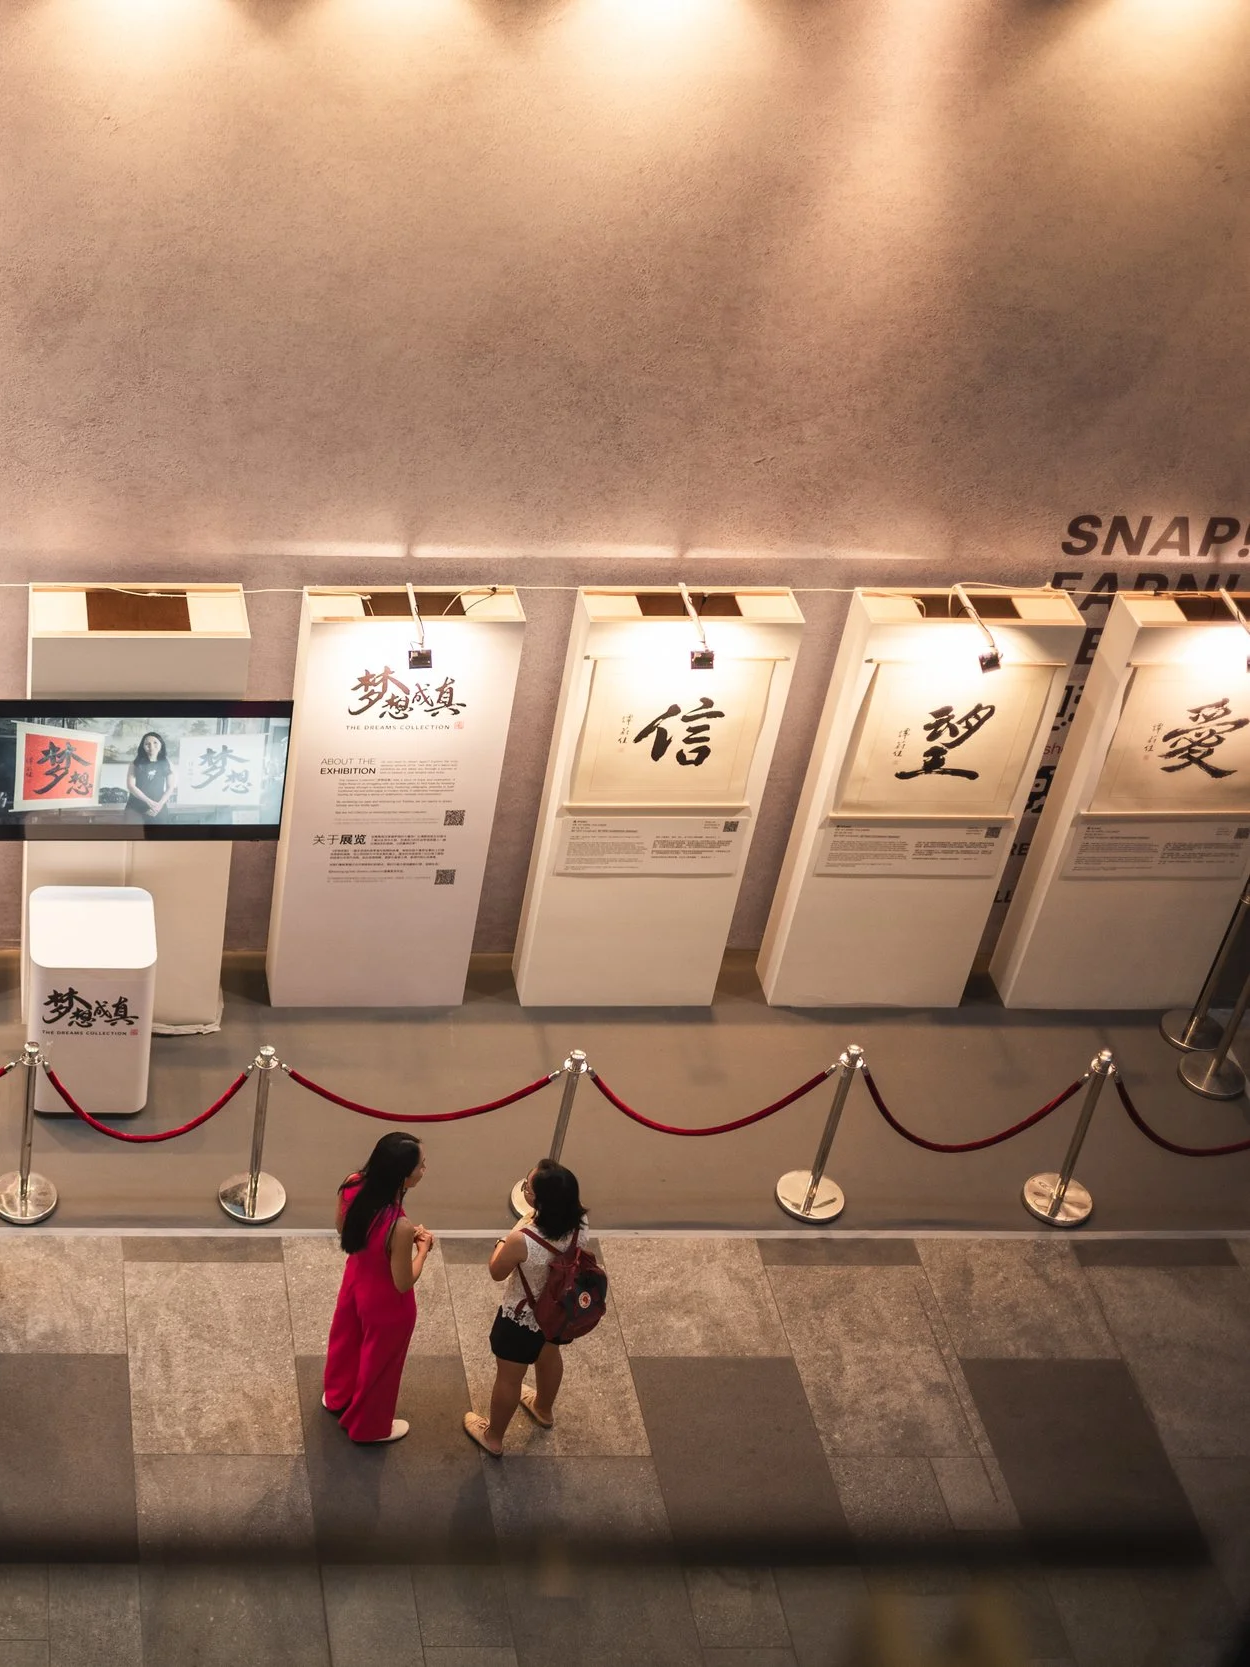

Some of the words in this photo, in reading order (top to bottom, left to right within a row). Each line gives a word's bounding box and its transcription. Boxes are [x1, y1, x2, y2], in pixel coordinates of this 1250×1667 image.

[348, 666, 467, 720] 梦想成真
[633, 696, 725, 766] 信
[894, 703, 995, 780] 望
[34, 741, 92, 796] 梦想
[320, 767, 377, 775] EXHIBITION
[312, 834, 367, 845] 关于展览
[42, 987, 139, 1028] 梦想成真
